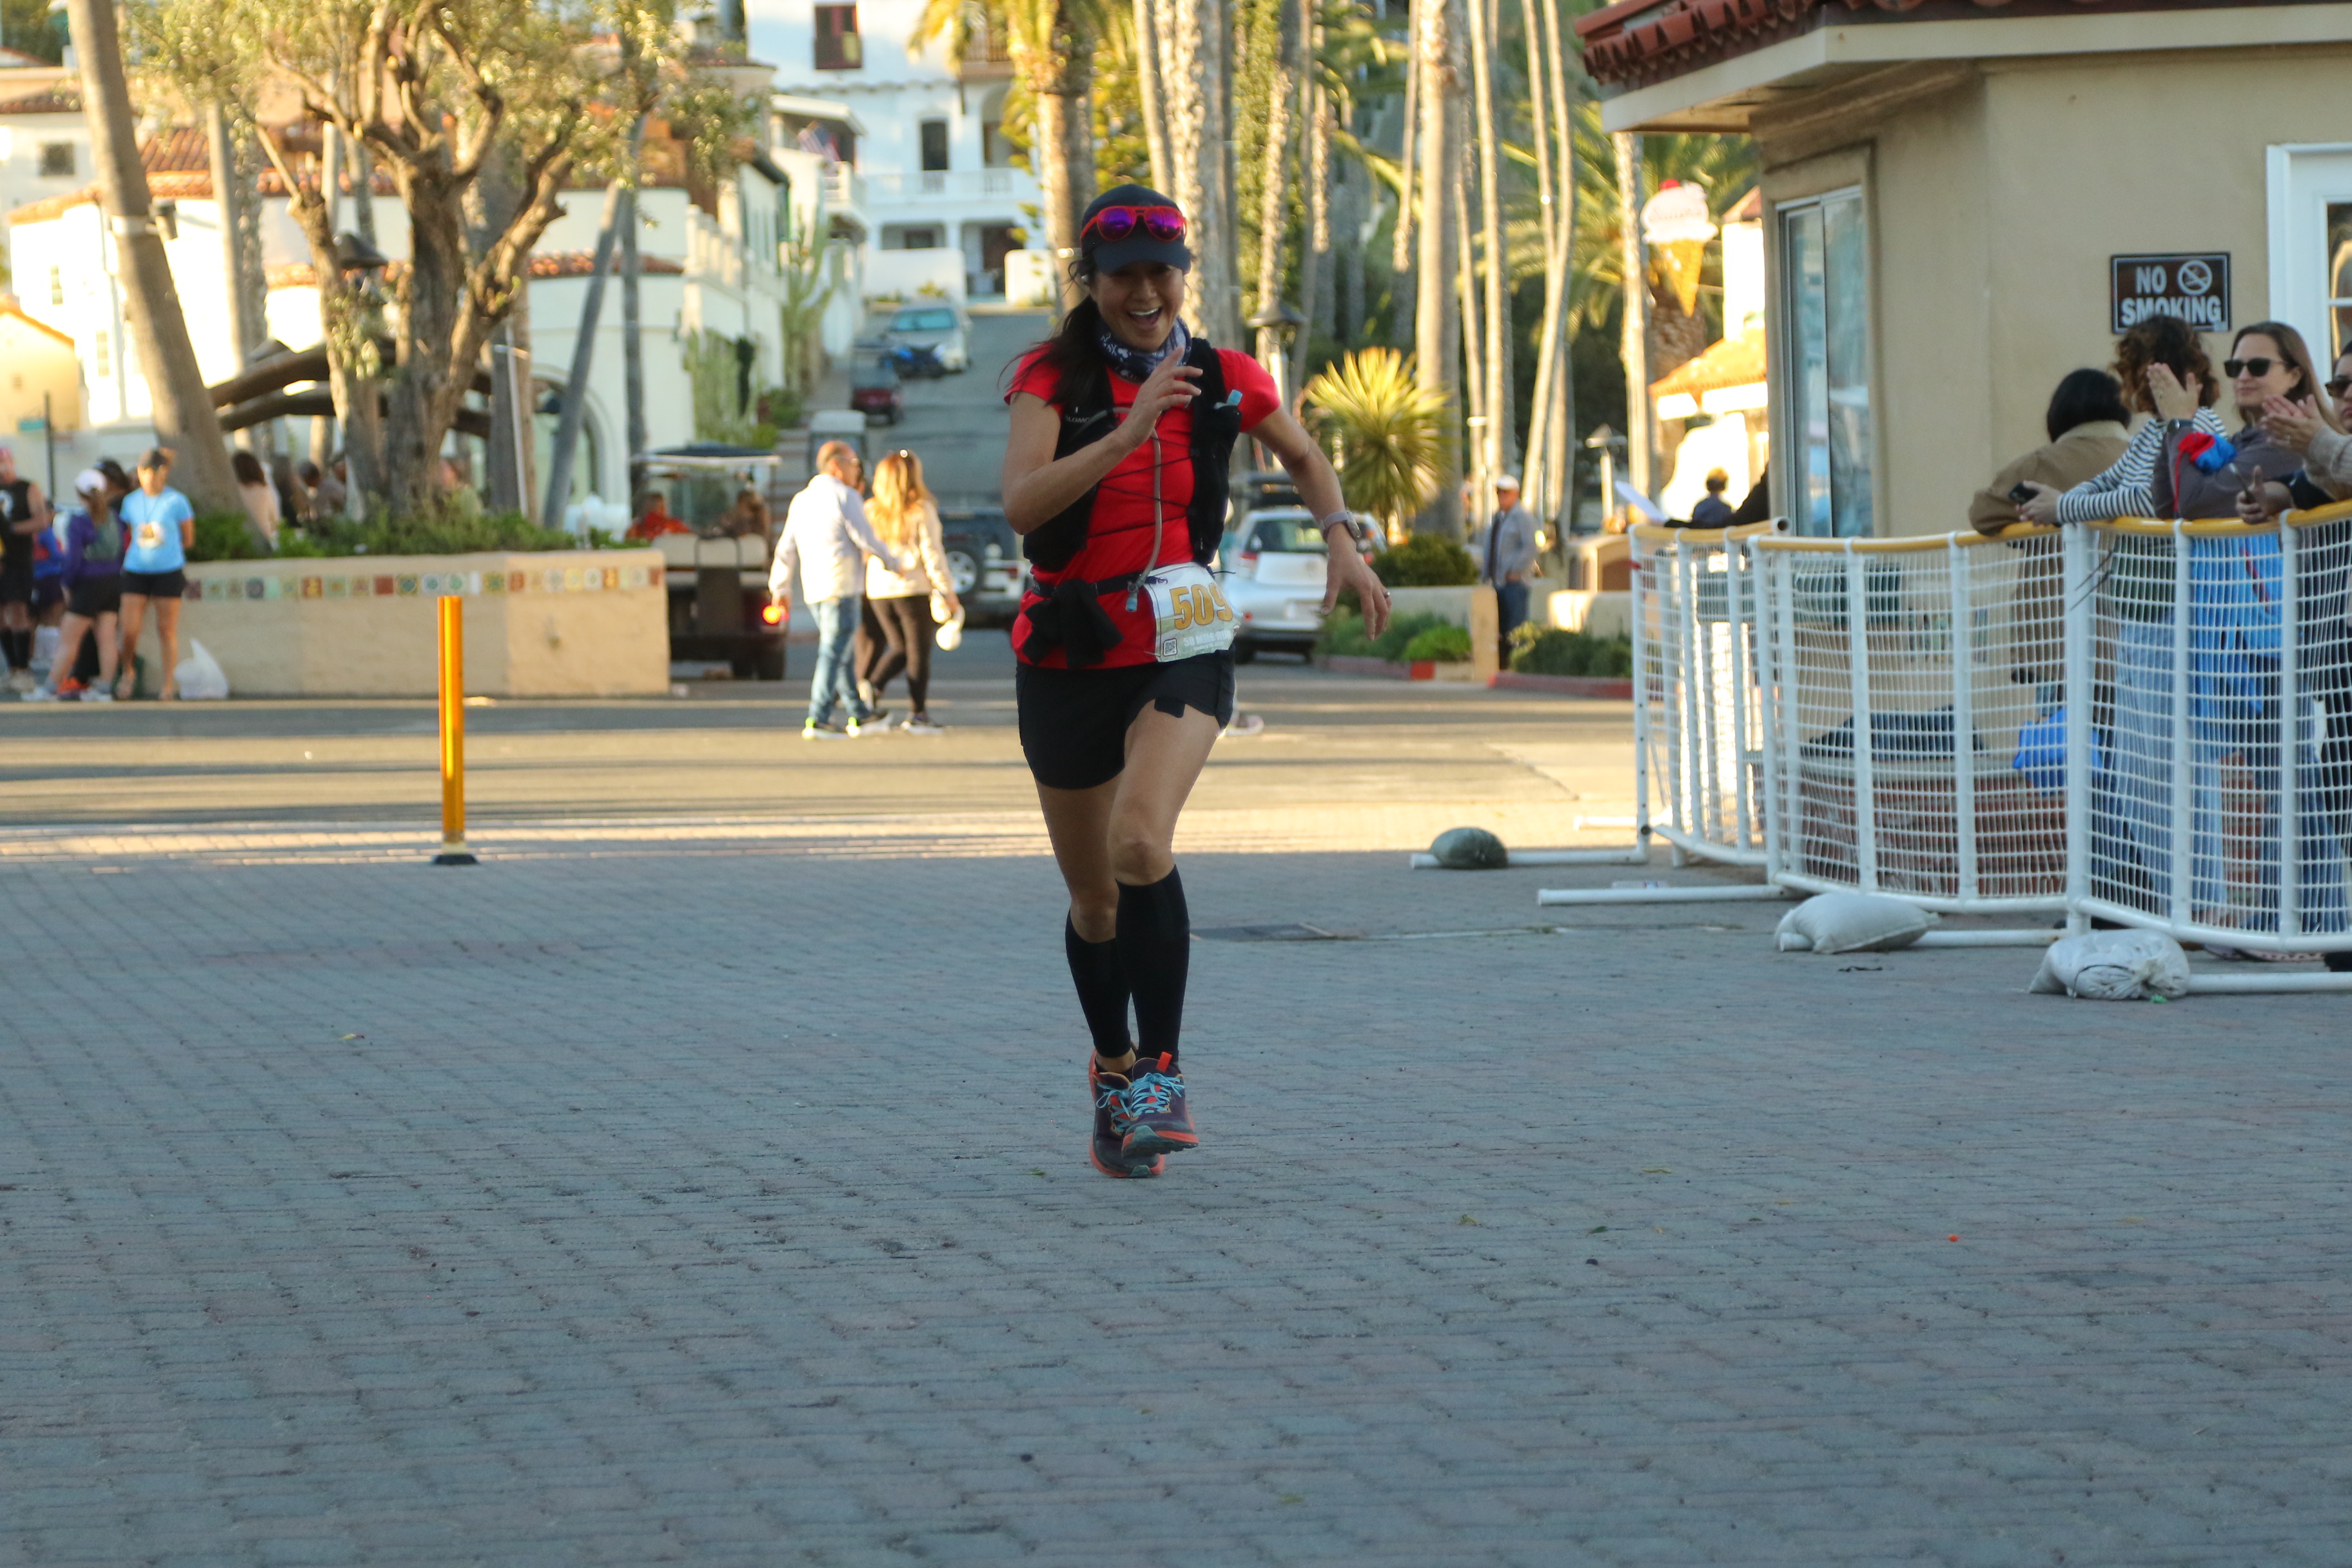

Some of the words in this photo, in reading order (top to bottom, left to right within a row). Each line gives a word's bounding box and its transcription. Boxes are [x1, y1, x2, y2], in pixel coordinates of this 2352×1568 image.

[2135, 265, 2167, 294] NO
[2121, 295, 2222, 326] SMOKING
[1170, 583, 1233, 630] 509
[1184, 637, 1195, 647] 50
